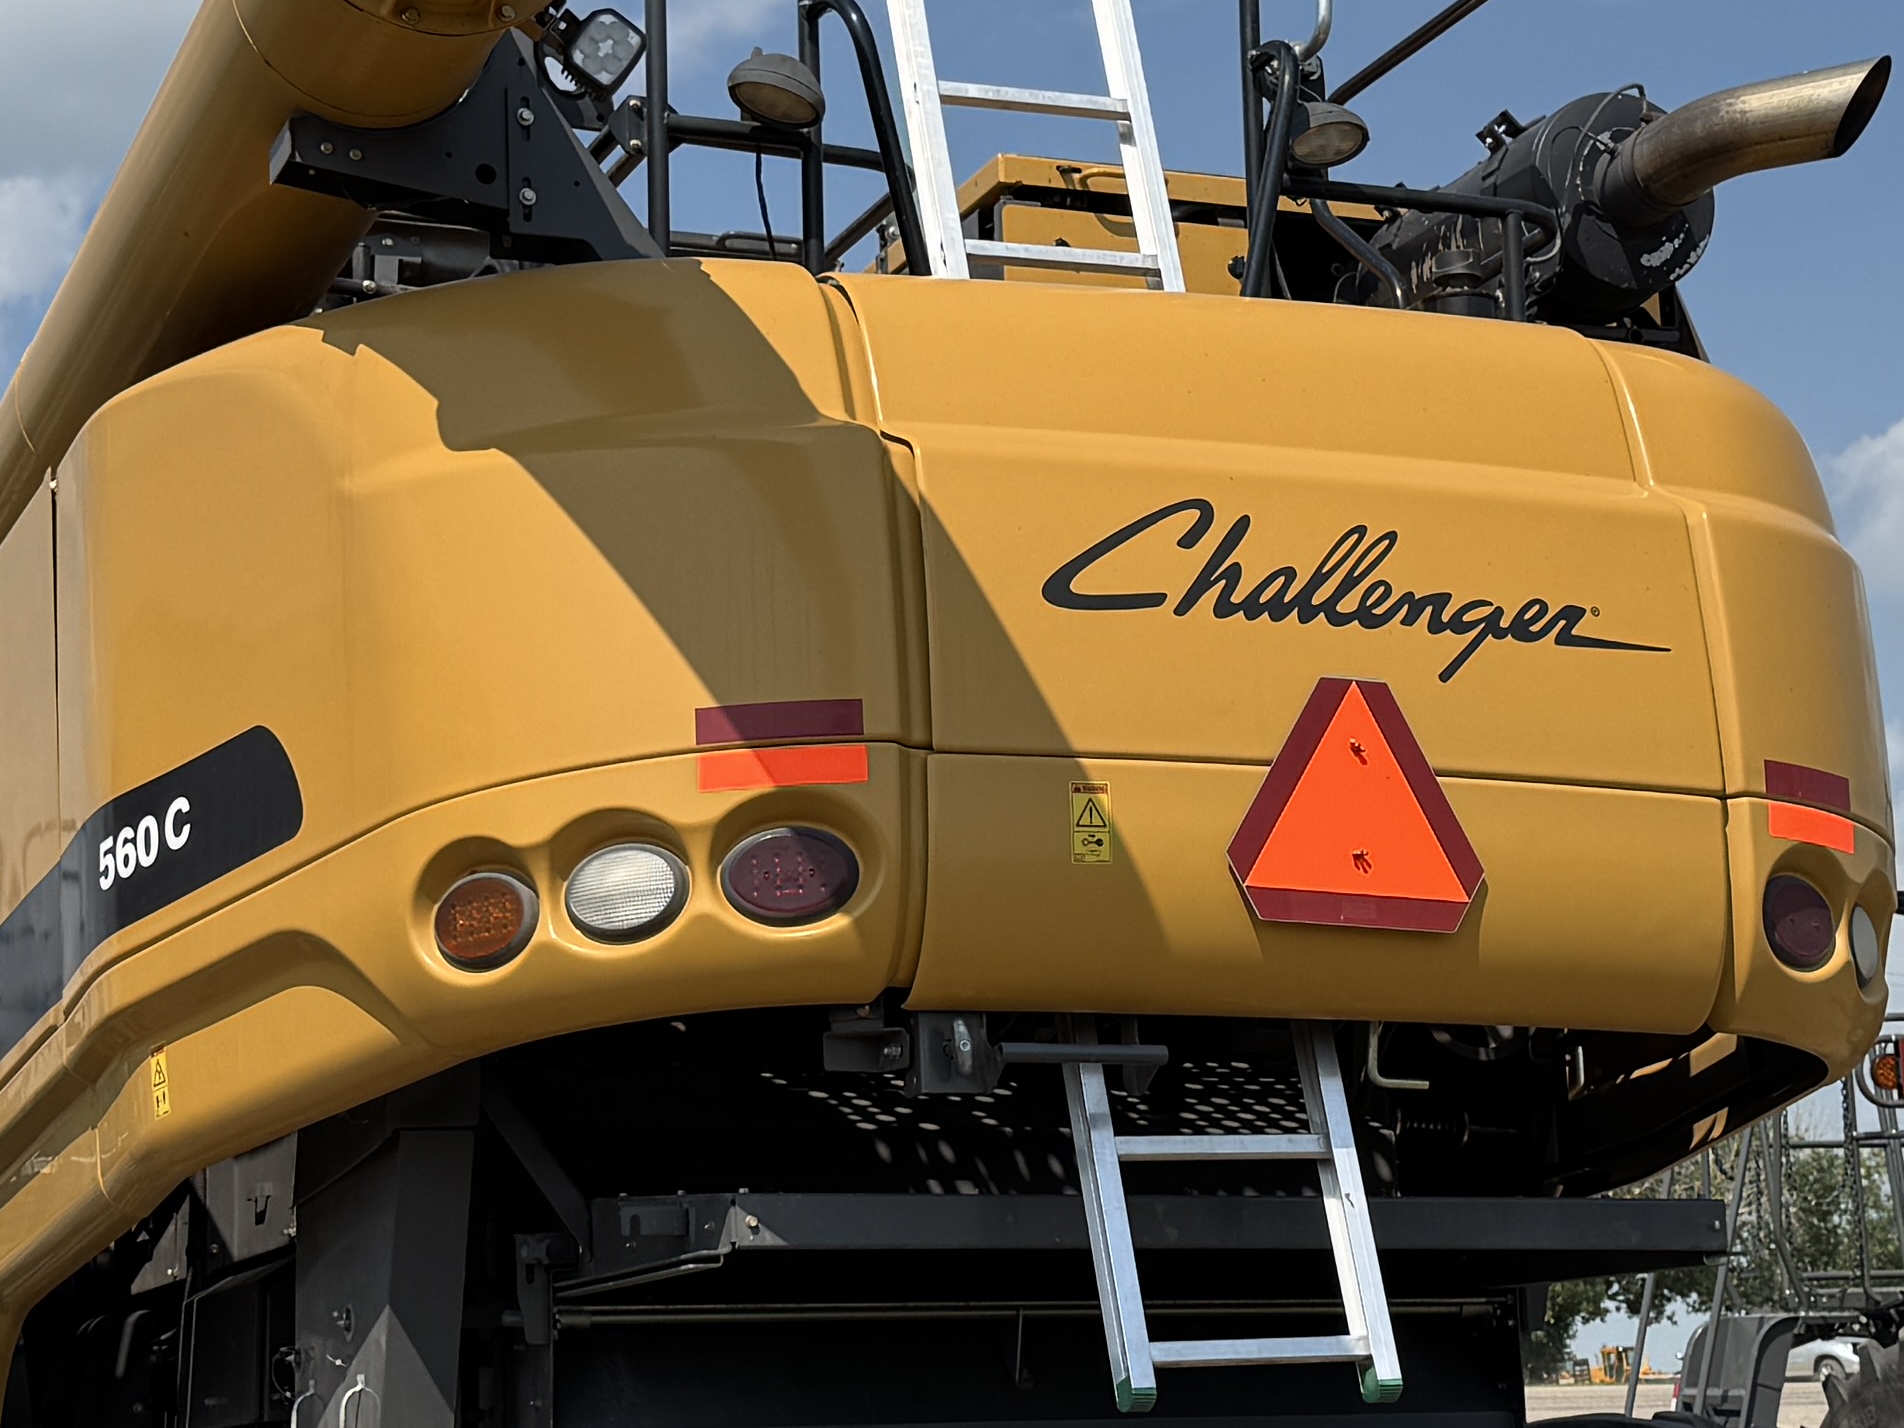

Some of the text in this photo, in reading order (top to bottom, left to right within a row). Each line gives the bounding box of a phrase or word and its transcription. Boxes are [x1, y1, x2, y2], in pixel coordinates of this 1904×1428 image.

[1041, 498, 1672, 683] Challenger
[99, 796, 191, 891] 560 C
